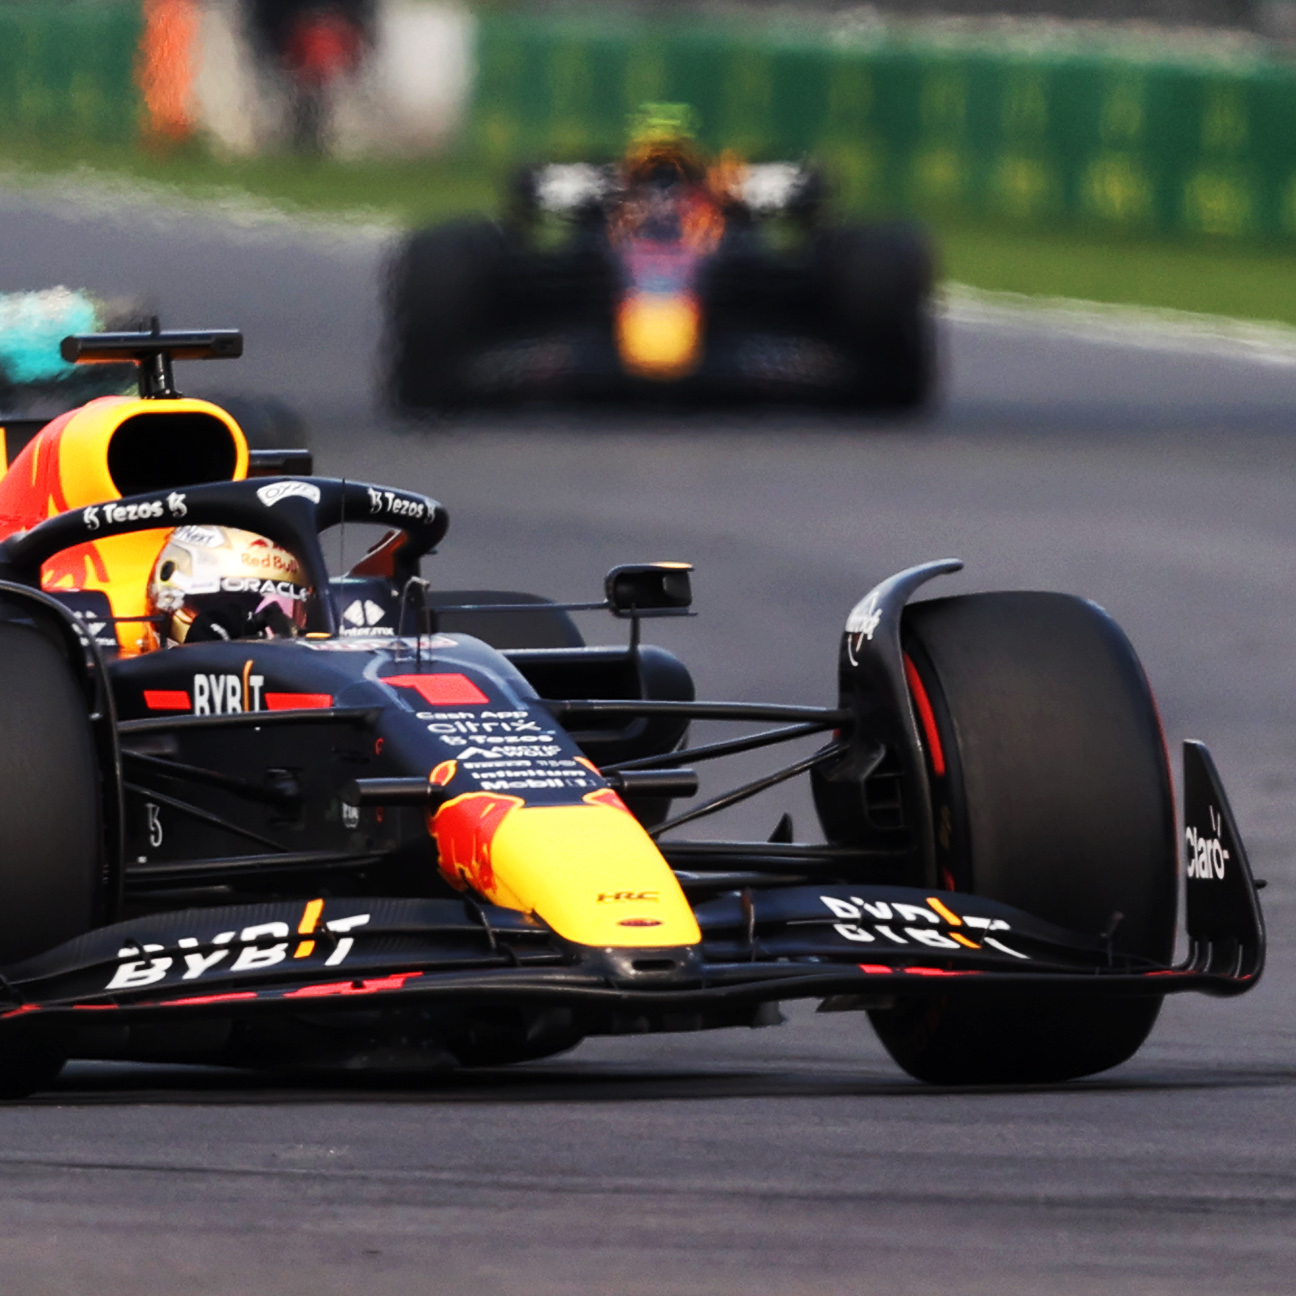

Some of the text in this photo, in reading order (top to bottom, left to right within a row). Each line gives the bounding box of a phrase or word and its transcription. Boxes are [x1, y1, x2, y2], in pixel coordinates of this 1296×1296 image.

[104, 501, 163, 524] Tezos
[384, 492, 424, 518] Tezos
[416, 710, 529, 720] Cash App
